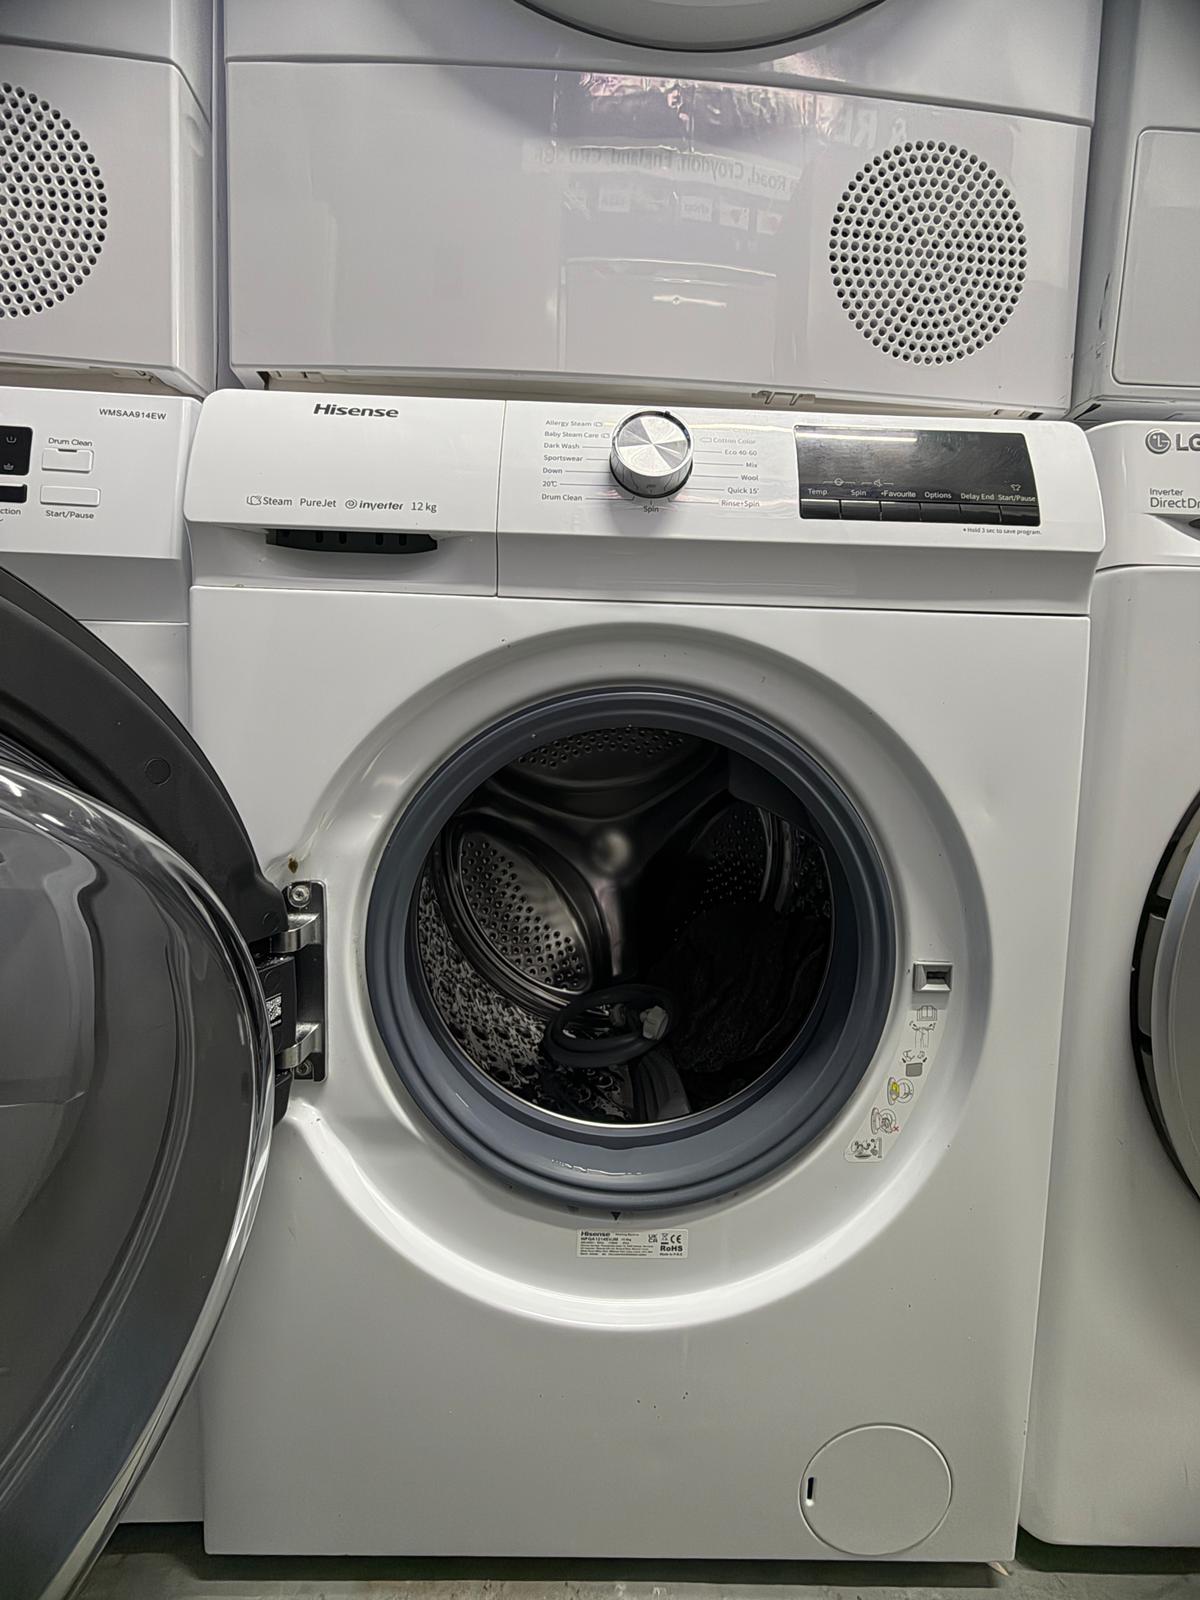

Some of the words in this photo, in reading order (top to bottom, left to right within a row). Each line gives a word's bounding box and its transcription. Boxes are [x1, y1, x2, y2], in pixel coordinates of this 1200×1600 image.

[99, 408, 167, 420] WMSAA914EW
[313, 403, 399, 418] Hisense
[545, 419, 569, 428] Allergy
[48, 438, 69, 446] Drum
[71, 438, 93, 447] Clean
[543, 454, 583, 462] Sportswear
[727, 487, 748, 495] Quick
[808, 488, 828, 496] Temp
[924, 491, 952, 499] Options
[1149, 487, 1184, 497] Inverter
[541, 493, 562, 501] Drum
[562, 494, 583, 502] Clean
[960, 493, 980, 501] Delay
[997, 494, 1036, 502] Start/Pause
[263, 495, 293, 506] Steam
[299, 497, 337, 508] PureJet
[359, 500, 404, 511] inverter
[411, 501, 424, 511] 12
[425, 502, 437, 513] kg
[643, 505, 659, 514] Spin
[46, 510, 94, 519] Start/Pause
